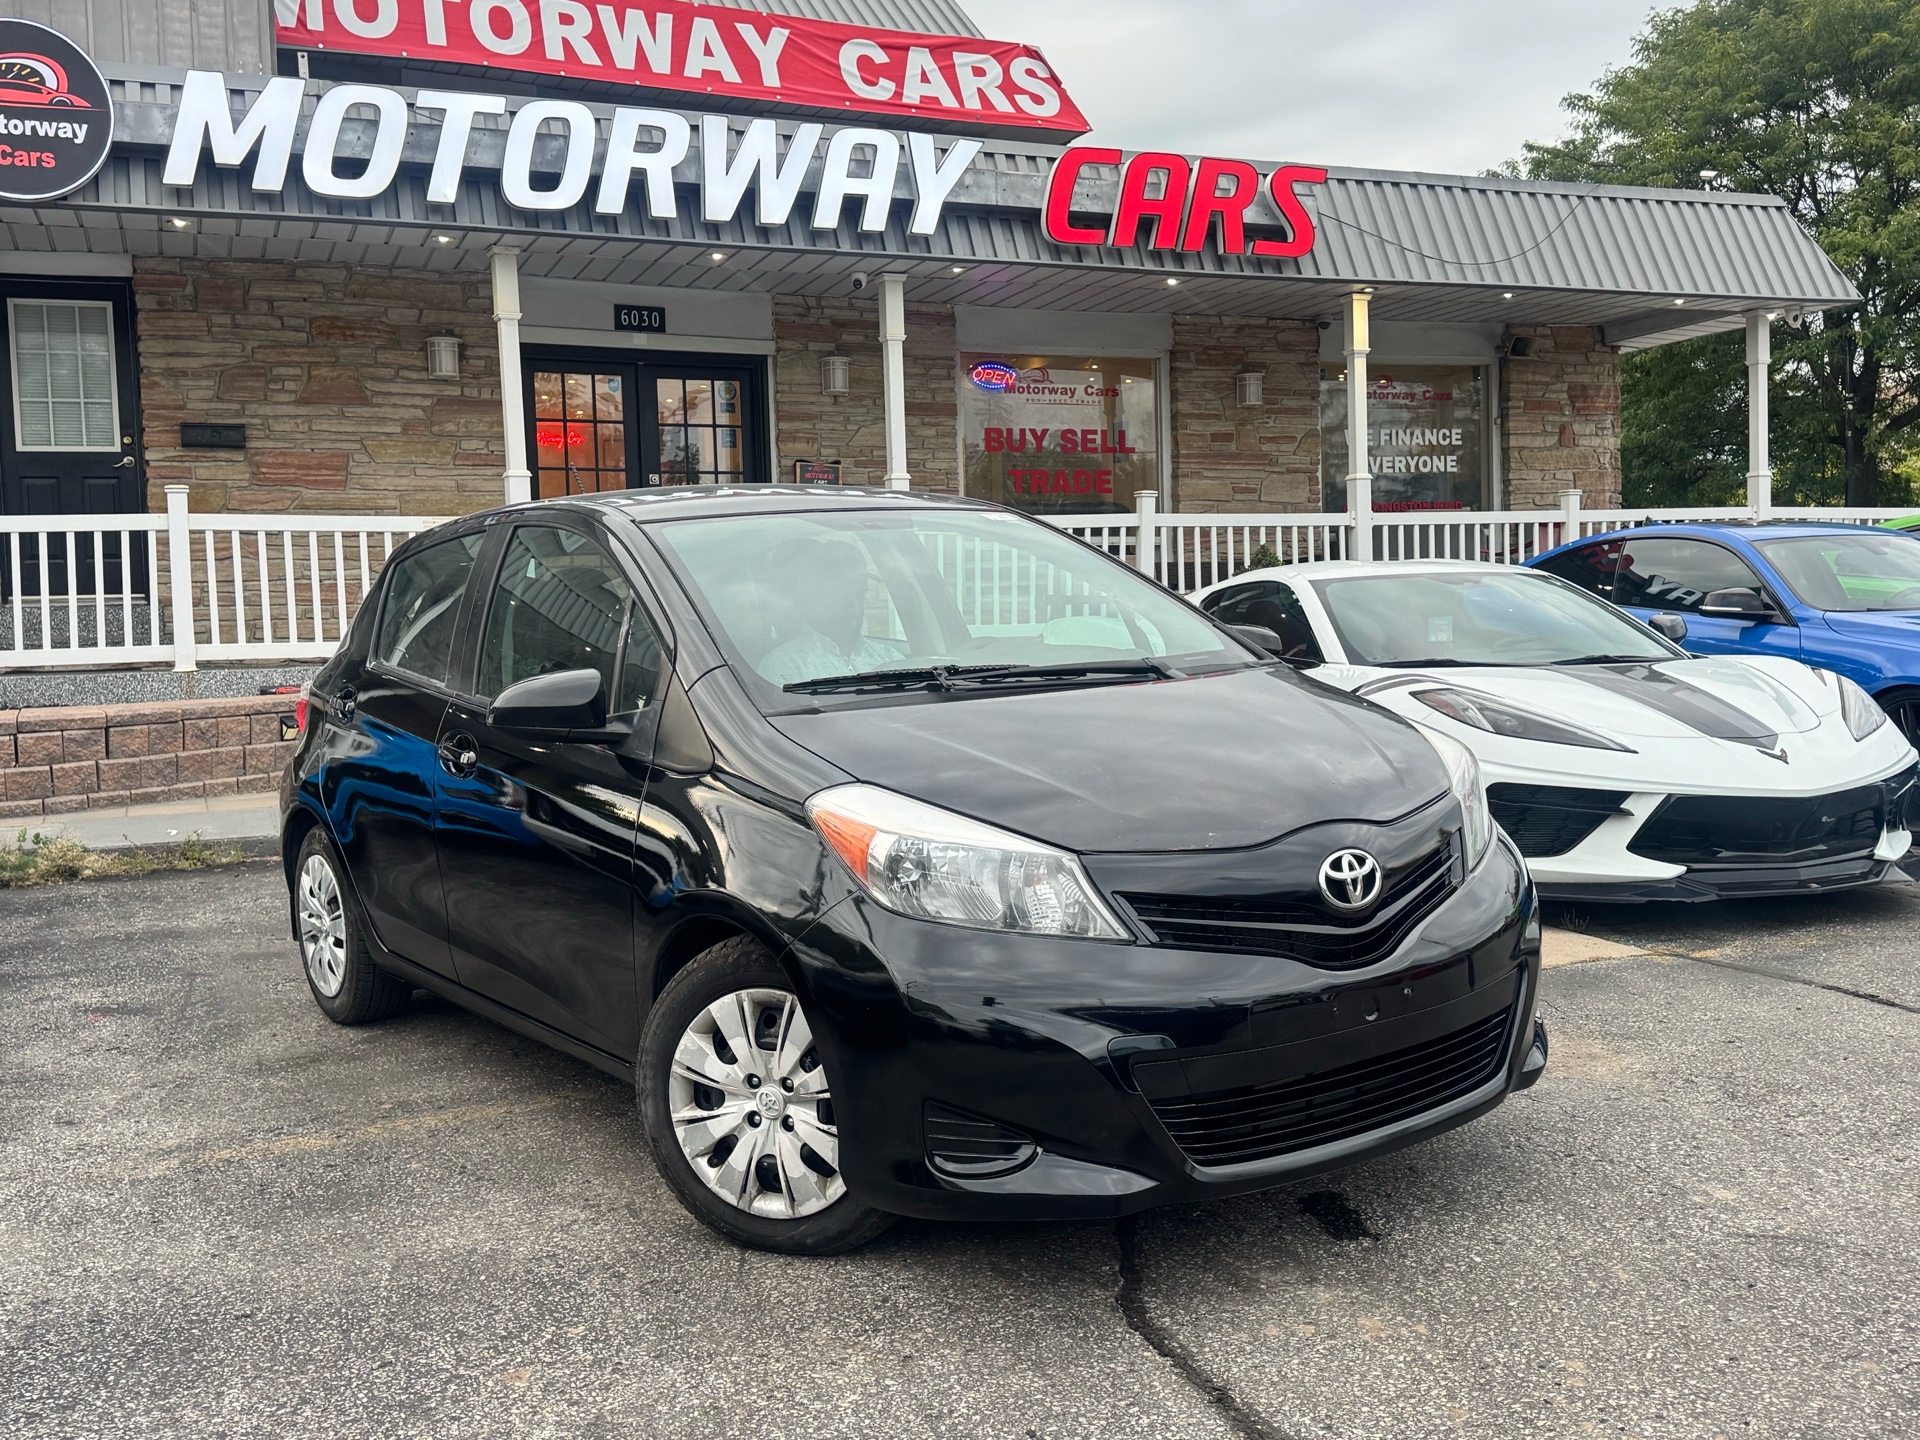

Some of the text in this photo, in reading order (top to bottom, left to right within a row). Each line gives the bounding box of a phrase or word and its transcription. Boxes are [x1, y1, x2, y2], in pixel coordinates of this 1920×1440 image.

[839, 38, 1061, 118] CARS
[0, 114, 88, 144] torway
[0, 144, 56, 168] Cars
[162, 69, 1328, 259] MOTORWAY CARS
[621, 309, 659, 327] 6030
[972, 367, 1017, 386] OPEN
[1004, 384, 1120, 399] Motorway Cars
[1367, 389, 1453, 402] otorway Cars
[984, 427, 1136, 454] BUY SELL
[1380, 428, 1463, 446] FINANCE
[1368, 455, 1458, 473] VERYONE
[805, 472, 836, 480] MOTORWAY
[1008, 469, 1113, 495] TRADE
